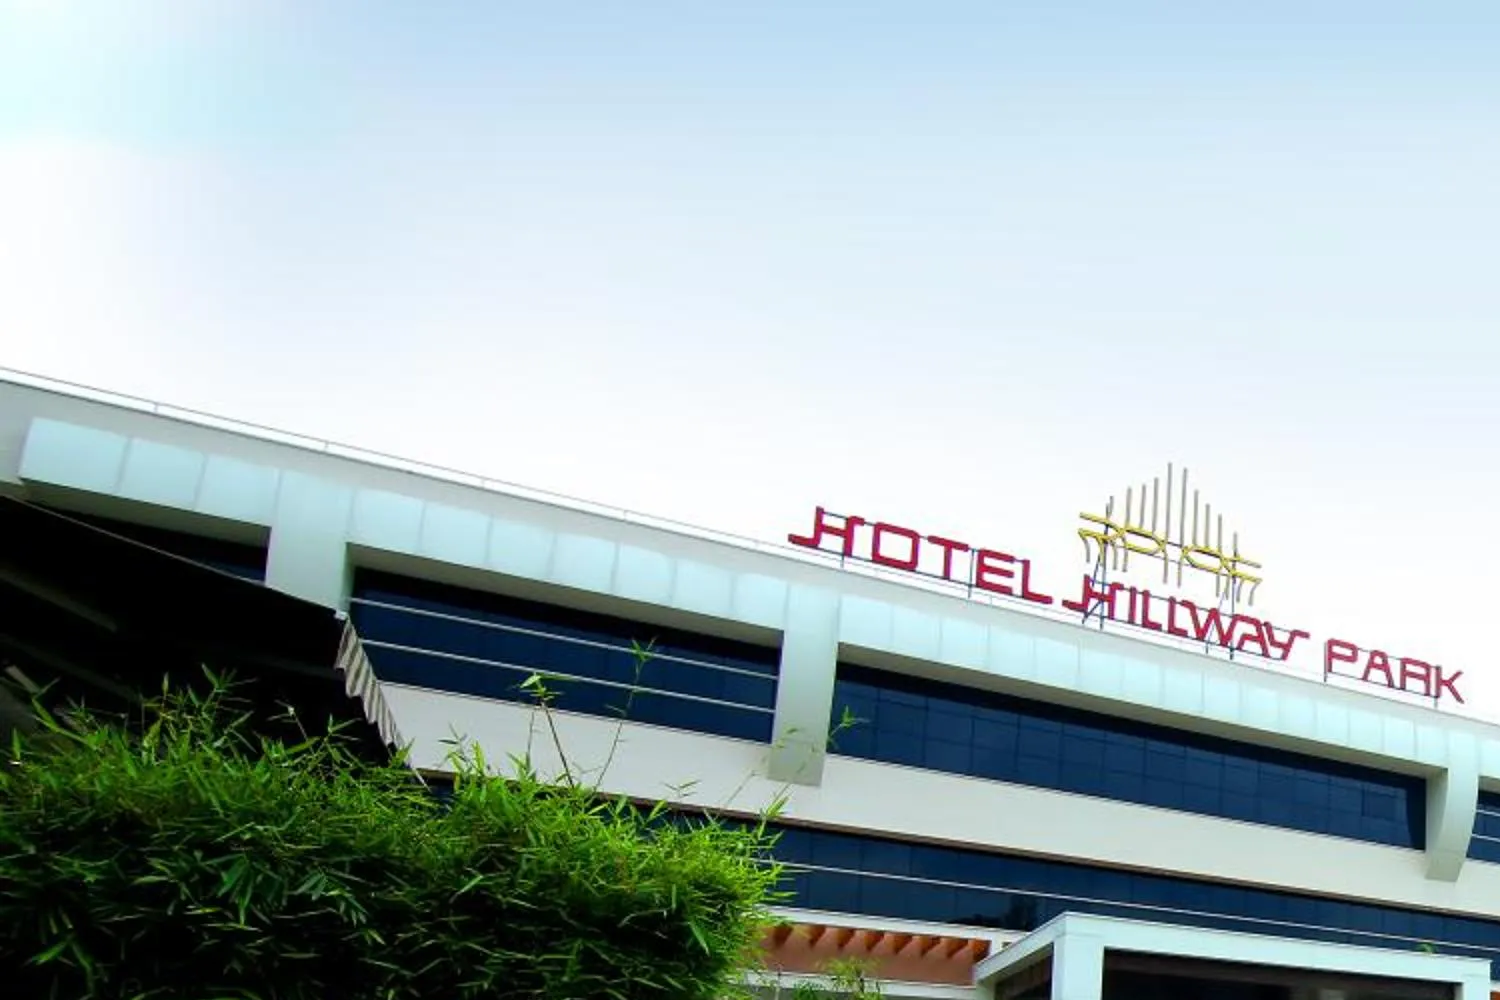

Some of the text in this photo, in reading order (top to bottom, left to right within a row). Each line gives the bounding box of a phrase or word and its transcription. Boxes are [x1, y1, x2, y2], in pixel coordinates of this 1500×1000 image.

[788, 507, 1466, 703] HOTEL HILLWAY PARK
